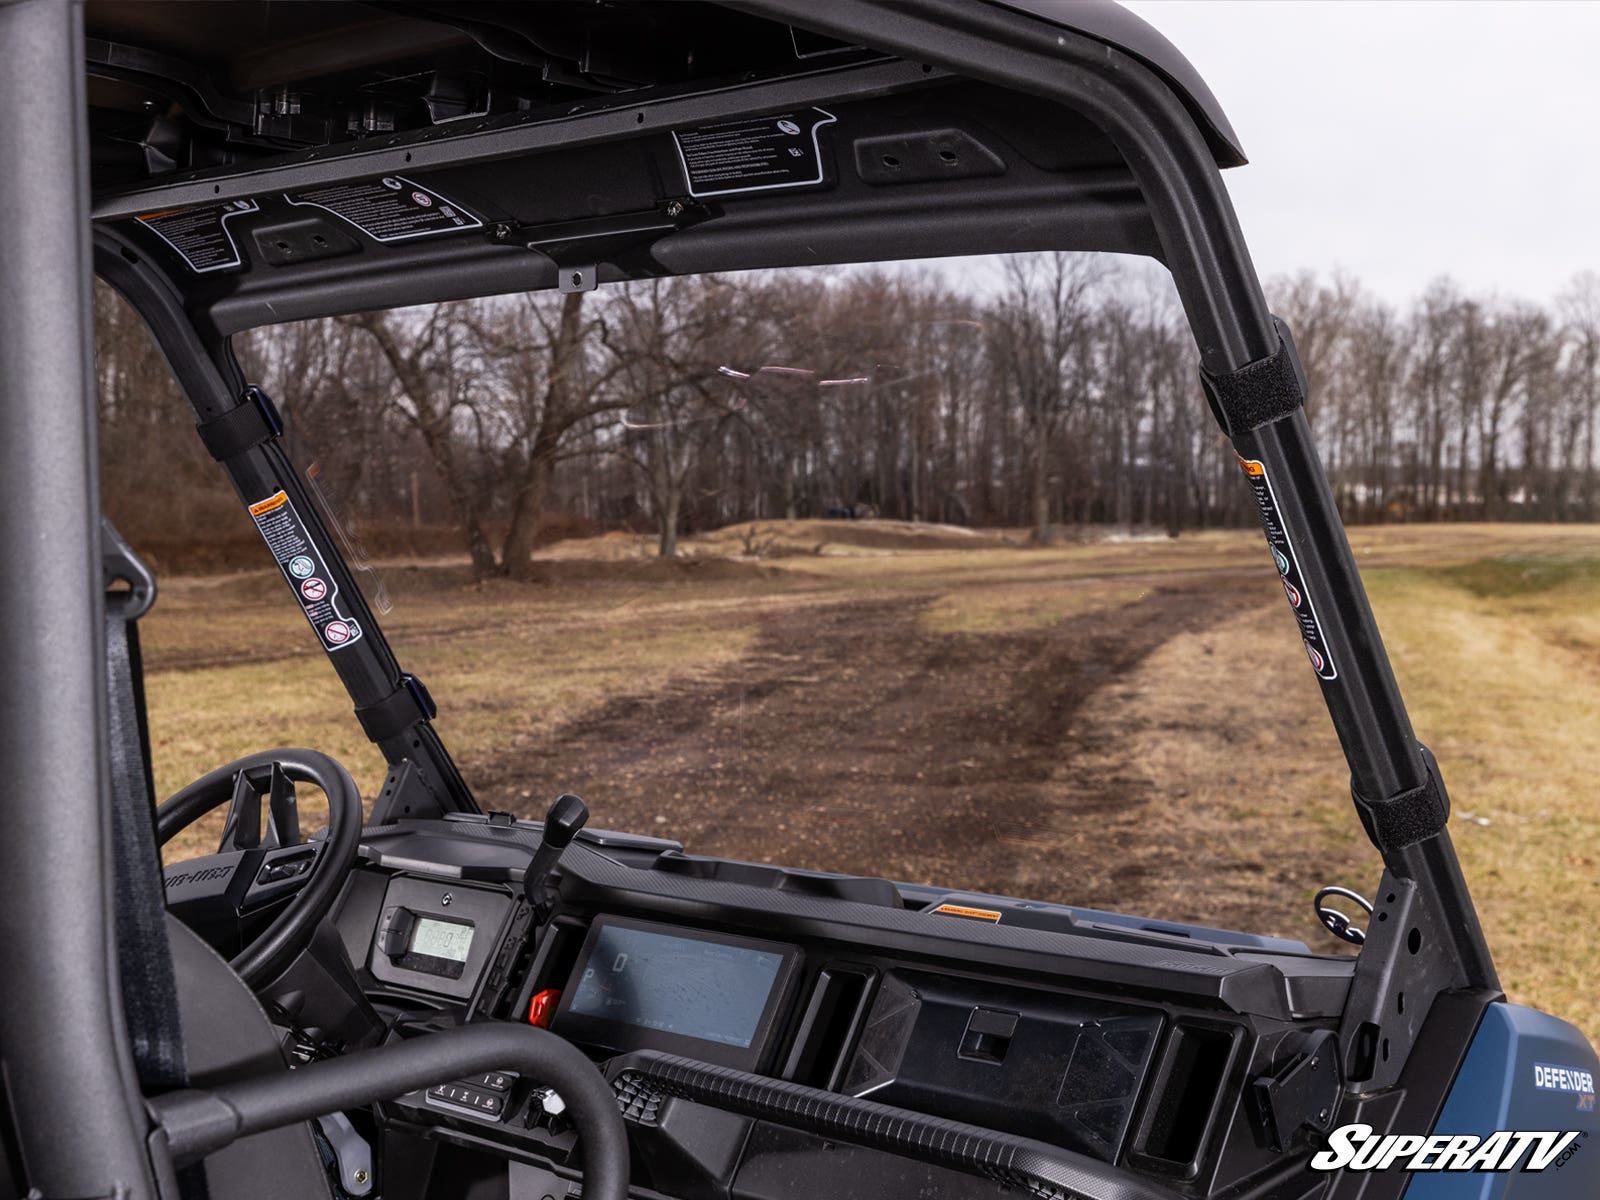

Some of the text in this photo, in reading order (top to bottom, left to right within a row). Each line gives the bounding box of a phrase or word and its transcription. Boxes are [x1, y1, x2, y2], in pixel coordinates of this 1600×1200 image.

[612, 952, 628, 972] 0
[582, 968, 594, 982] P
[1534, 1065, 1595, 1094] DEFENDER
[1578, 1094, 1595, 1110] XT
